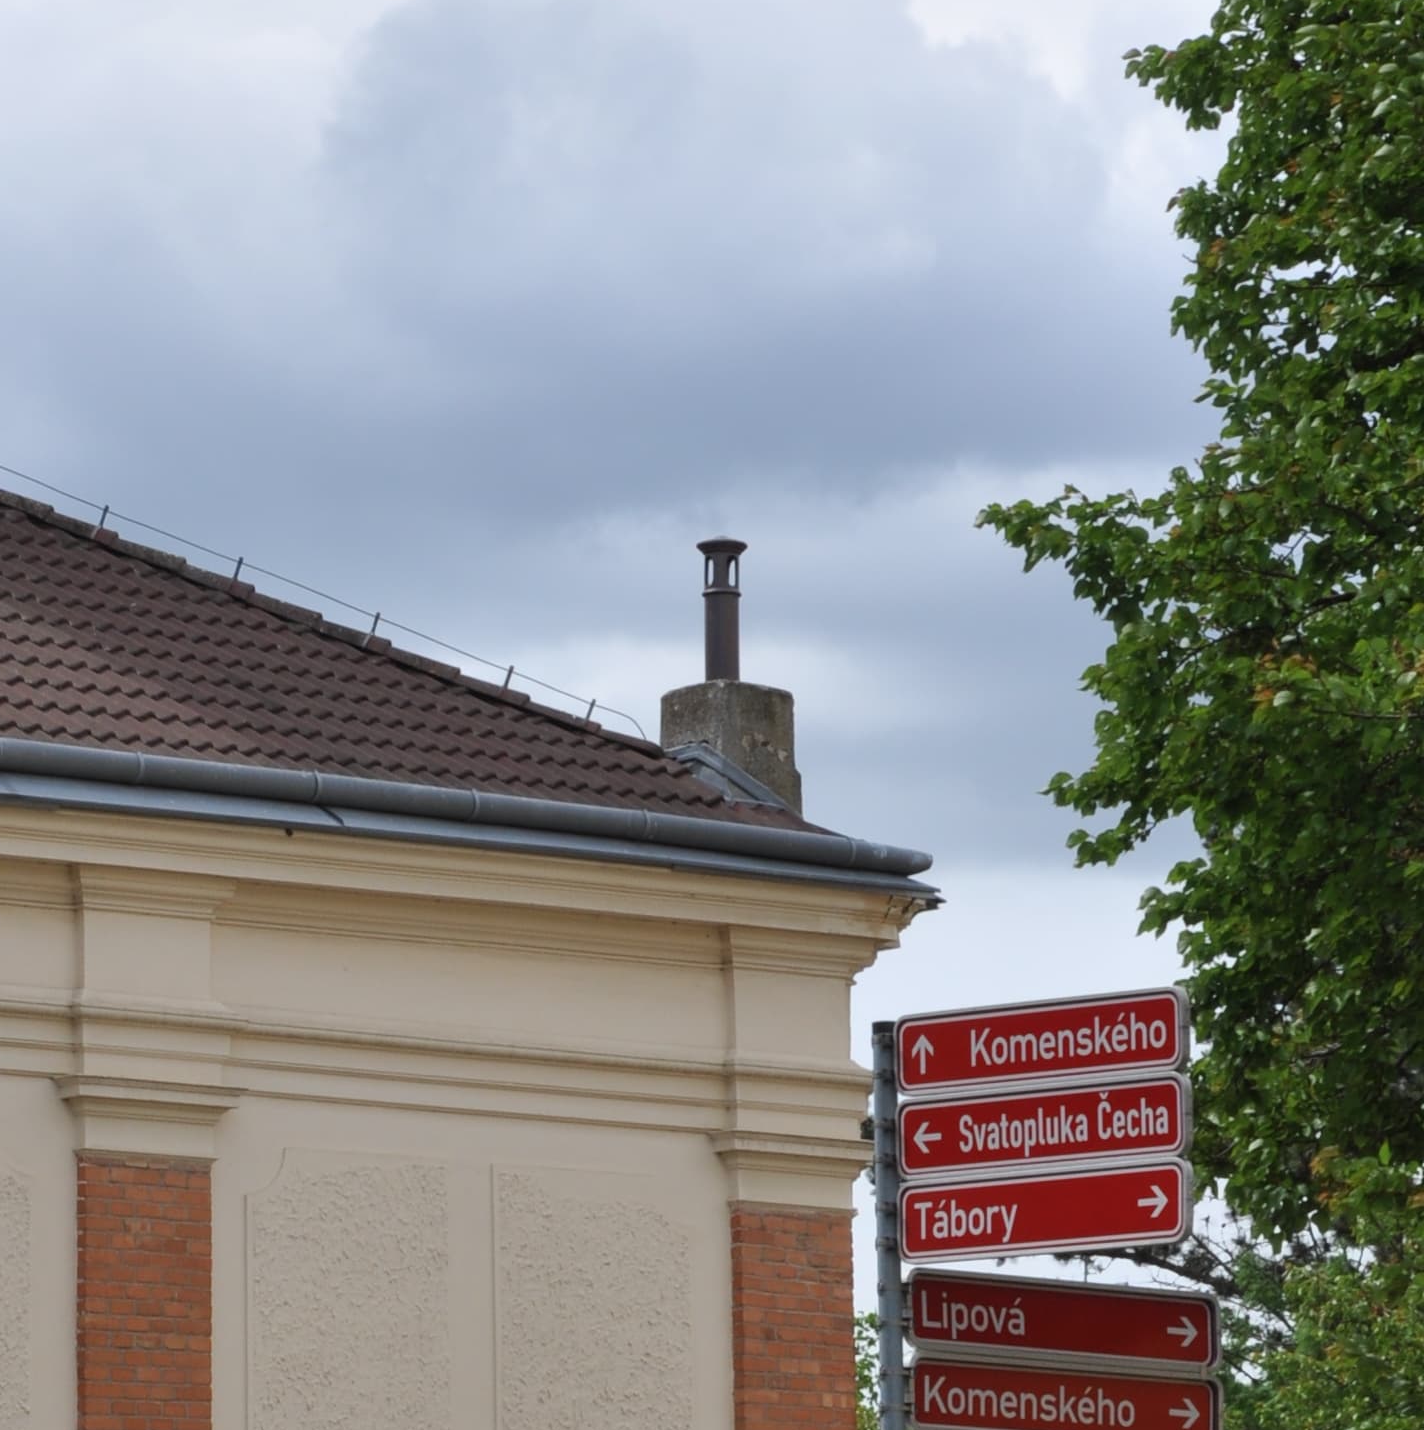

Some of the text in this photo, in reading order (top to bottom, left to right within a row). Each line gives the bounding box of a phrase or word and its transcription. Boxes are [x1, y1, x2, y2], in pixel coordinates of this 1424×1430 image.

[970, 1012, 1167, 1067] Komenského
[959, 1092, 1169, 1157] Svatopluka Čecha
[914, 1200, 1018, 1243] Tábory
[921, 1290, 1026, 1339] Lipová
[924, 1375, 1136, 1427] Komenského
